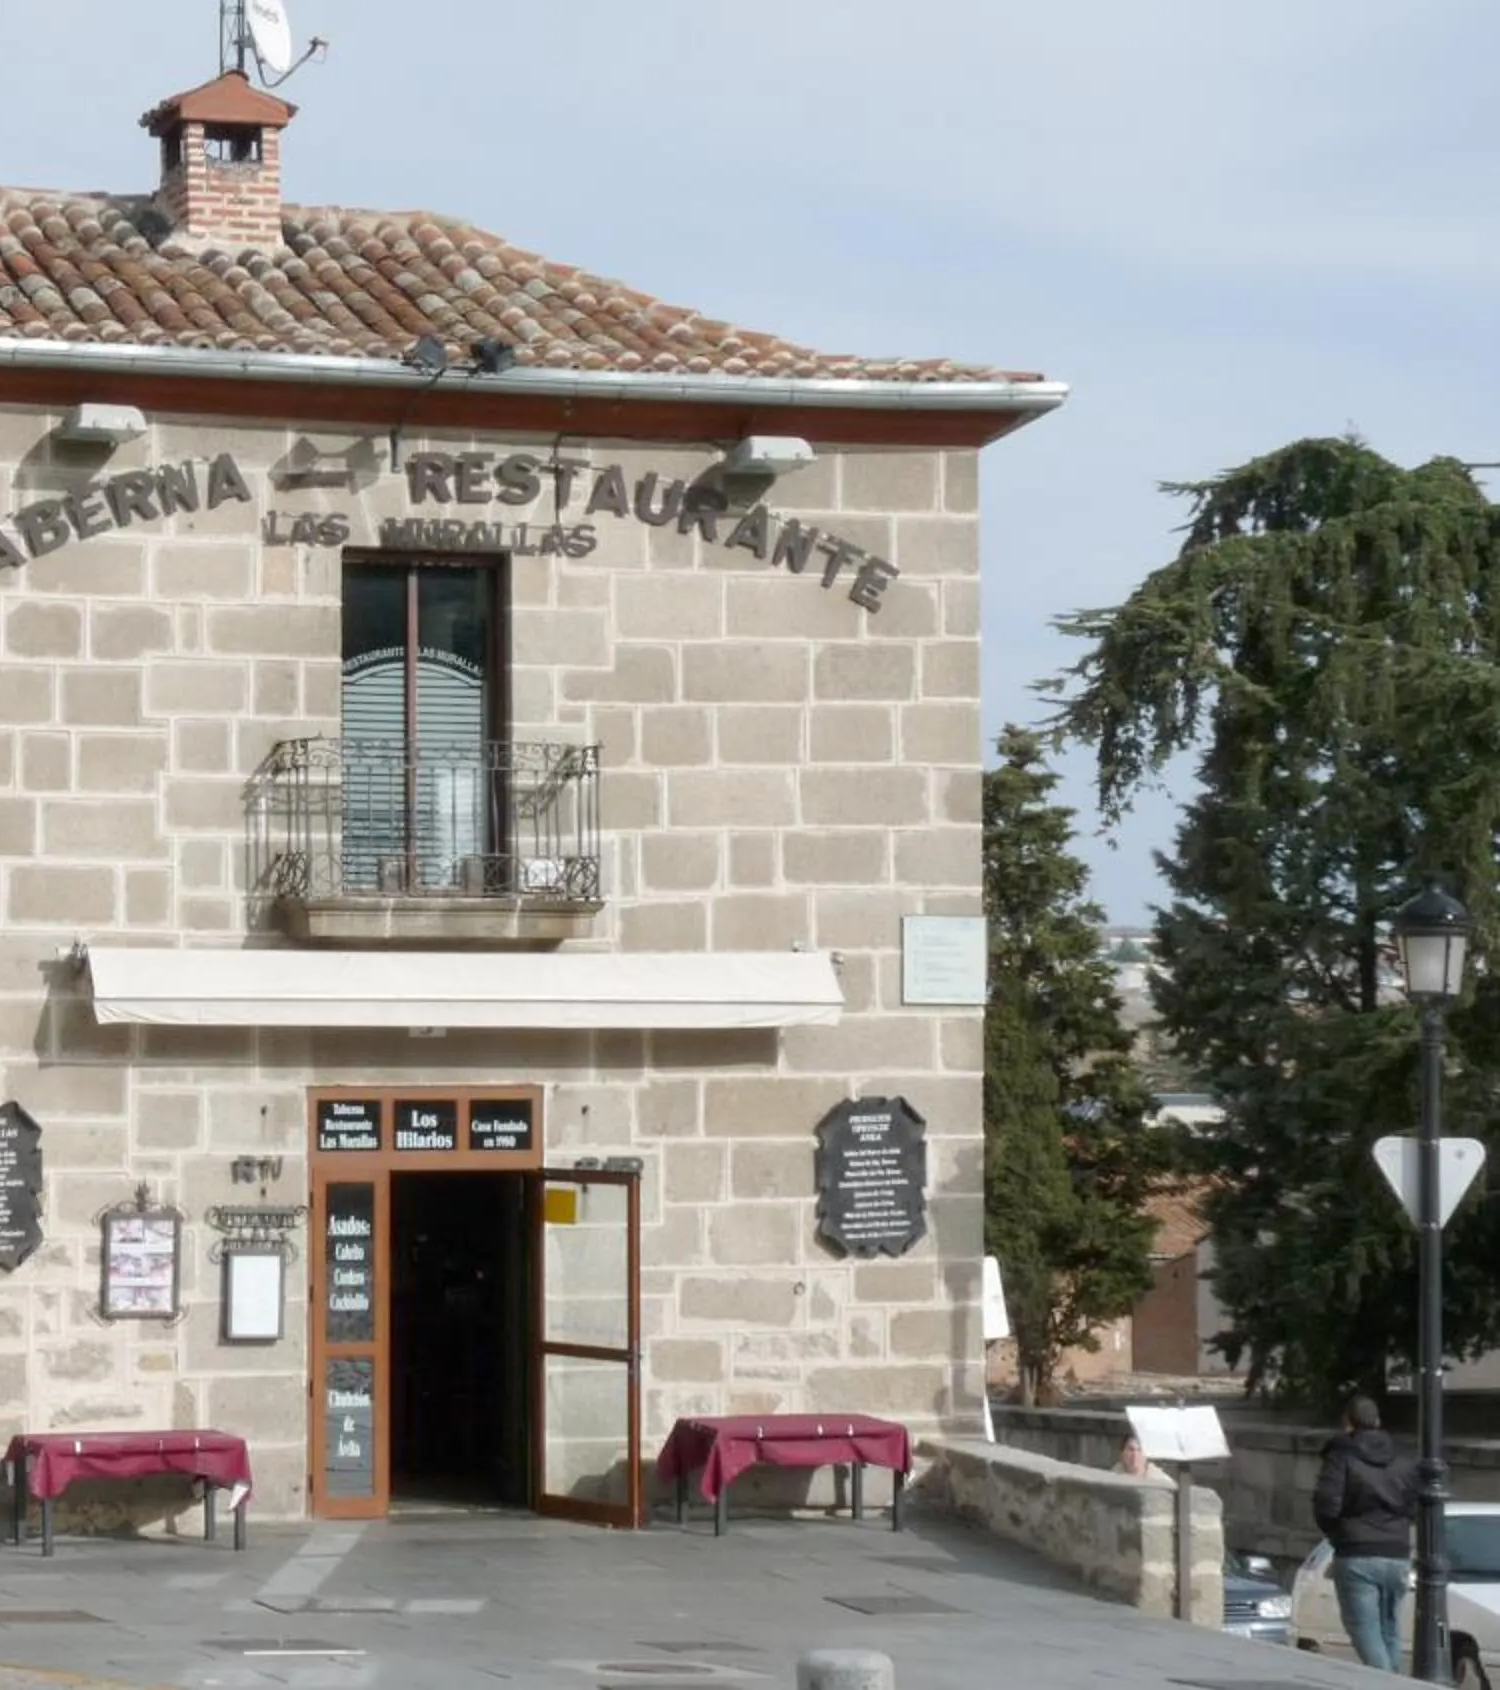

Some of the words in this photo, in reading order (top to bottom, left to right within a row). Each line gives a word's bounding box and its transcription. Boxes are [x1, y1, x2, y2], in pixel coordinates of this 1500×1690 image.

[264, 509, 350, 546] LAS
[379, 517, 598, 558] MURALLAS
[409, 451, 899, 614] RESTAURANTE
[325, 1119, 373, 1131] Restaurante
[411, 1109, 437, 1128] Los
[320, 1133, 337, 1148] Las
[339, 1133, 378, 1148] Murallas
[396, 1131, 453, 1149] Hilarios
[327, 1216, 371, 1236] Asados:
